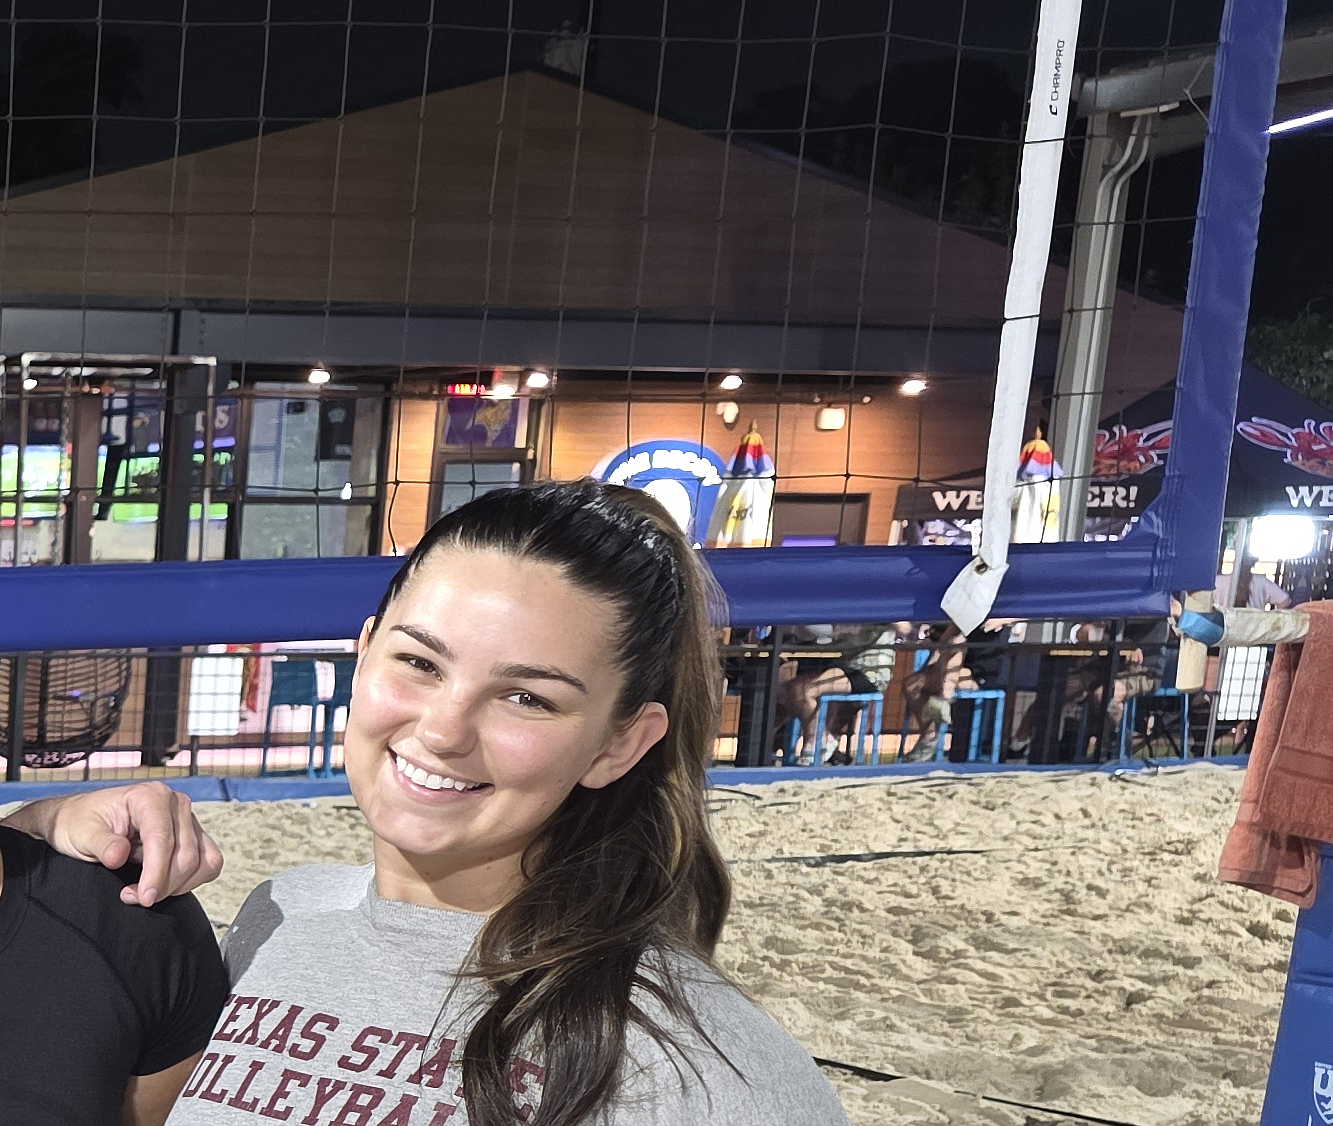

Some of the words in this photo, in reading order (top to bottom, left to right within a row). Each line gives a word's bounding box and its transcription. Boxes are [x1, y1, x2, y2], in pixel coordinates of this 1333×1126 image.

[1051, 39, 1065, 101] CHAMPRO
[932, 490, 984, 512] WE
[1086, 485, 1139, 508] ER!
[337, 1025, 546, 1122] STAE
